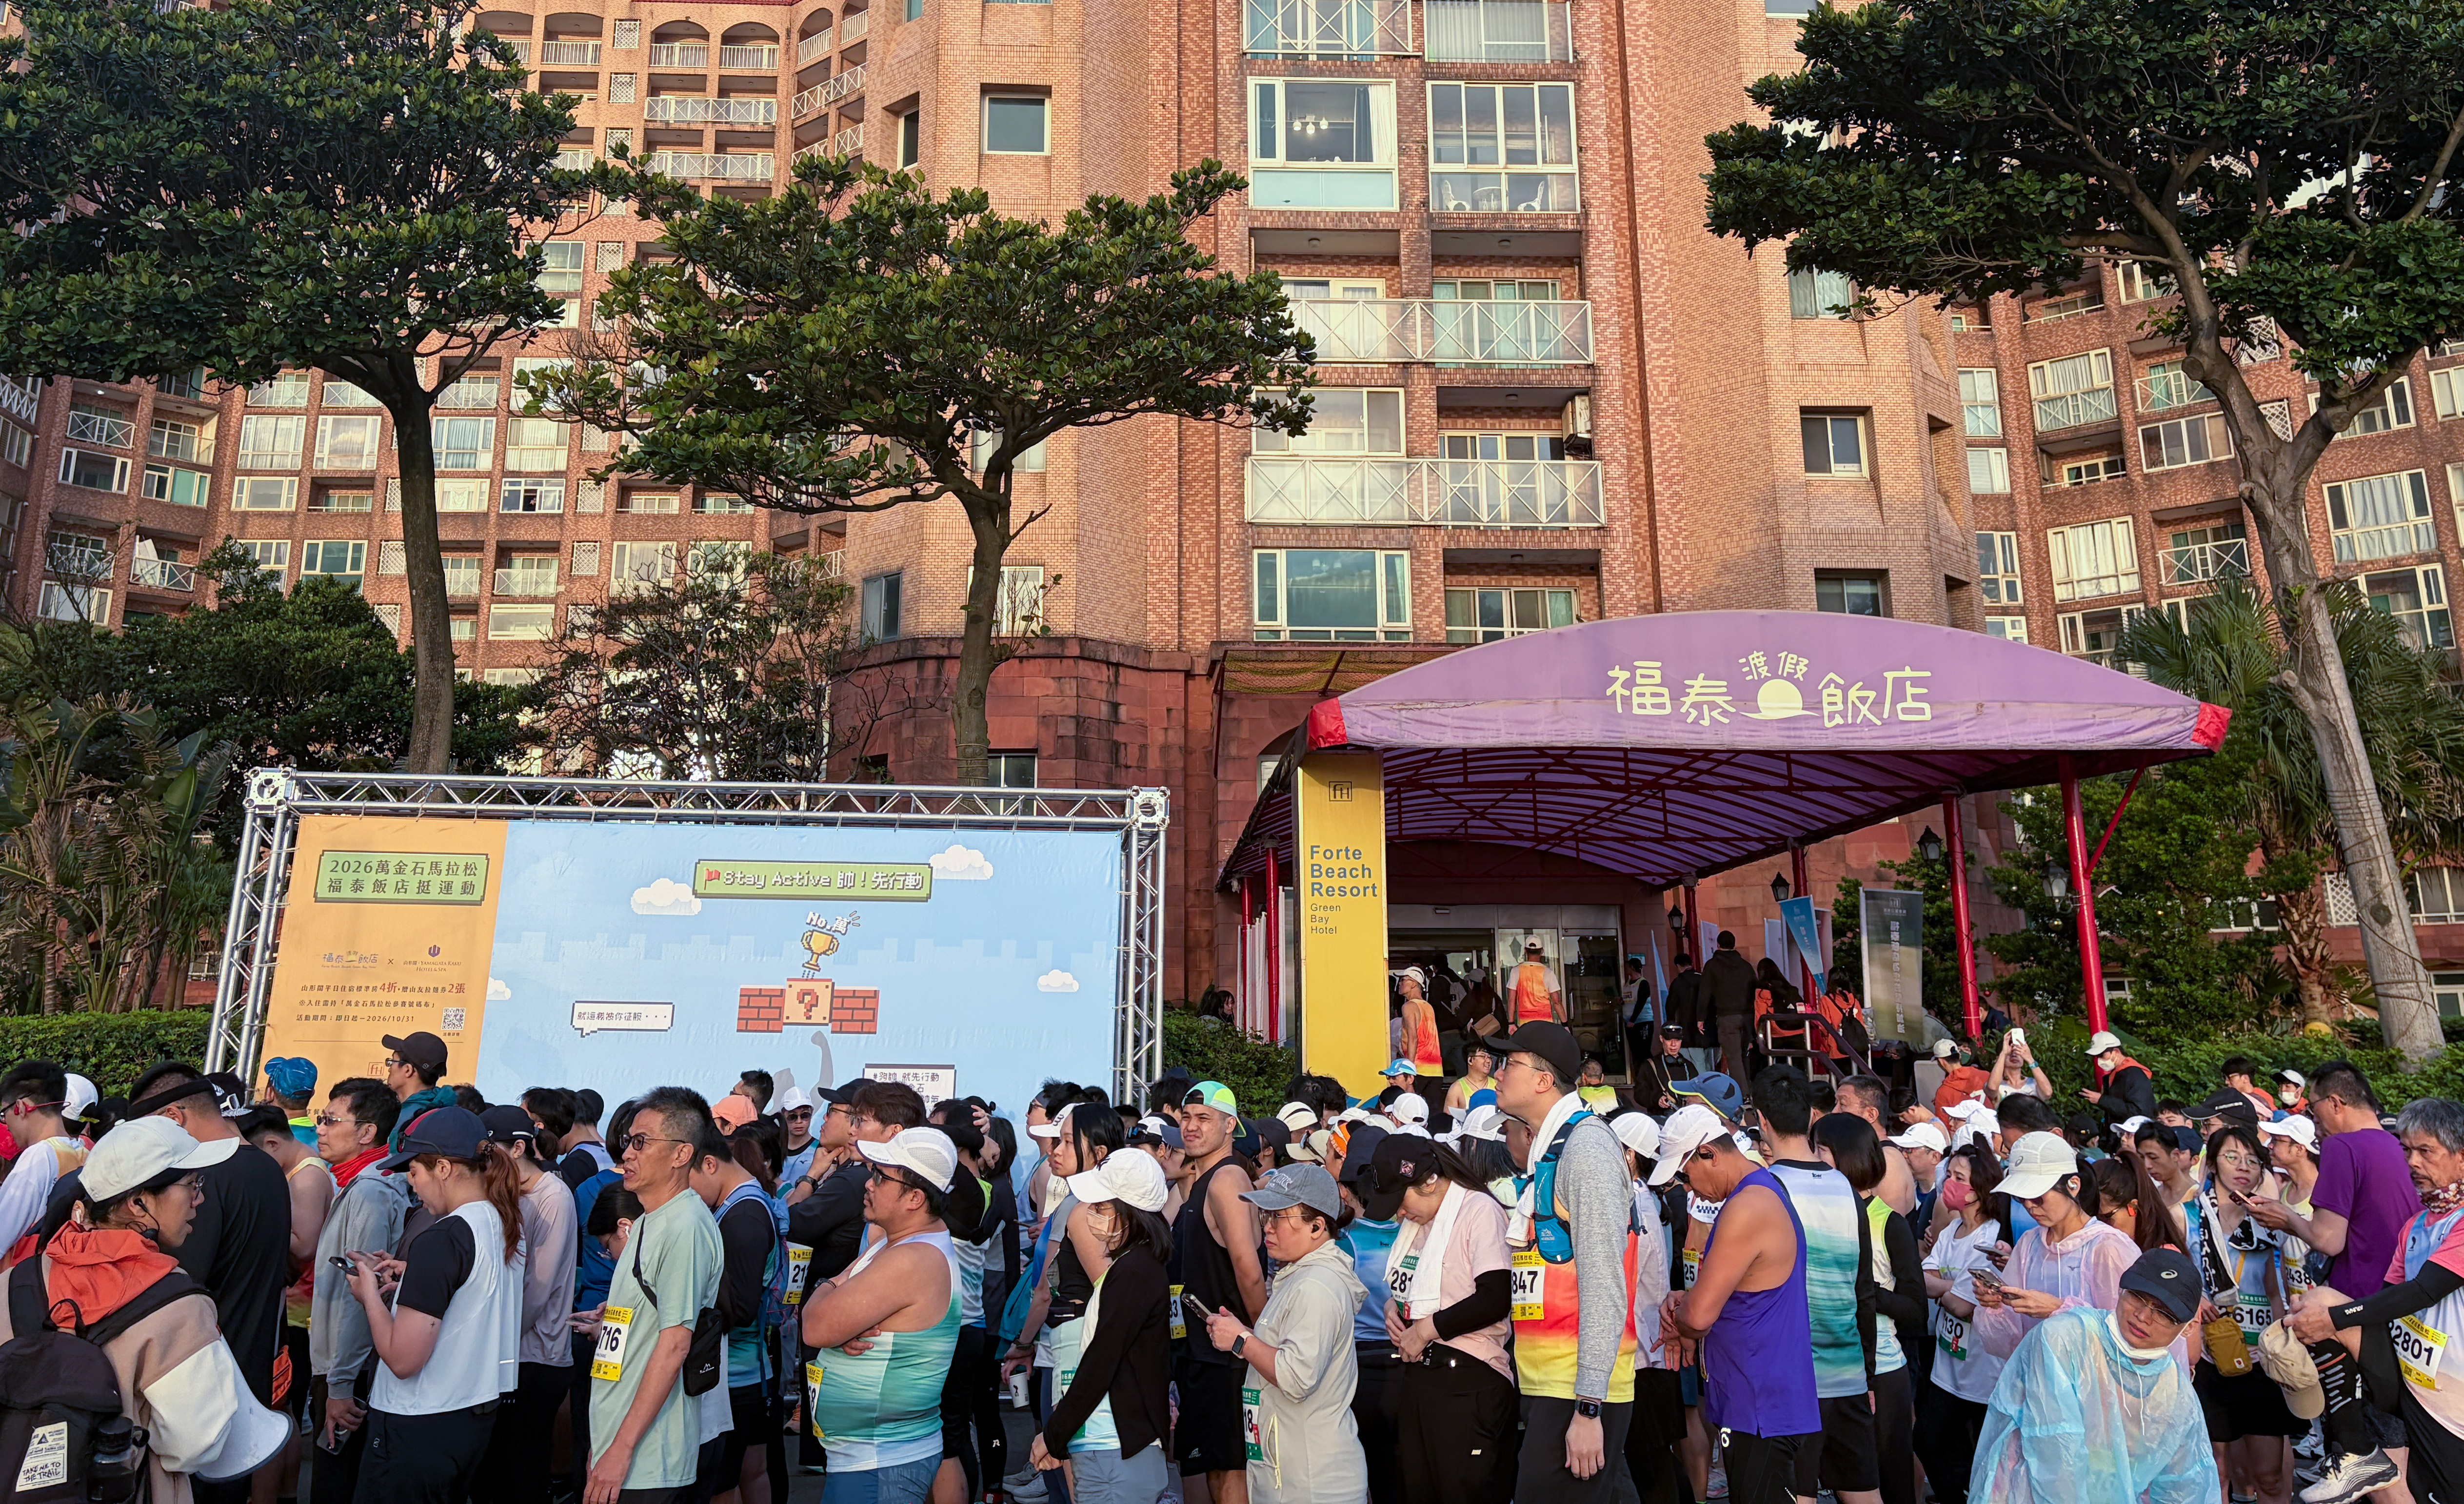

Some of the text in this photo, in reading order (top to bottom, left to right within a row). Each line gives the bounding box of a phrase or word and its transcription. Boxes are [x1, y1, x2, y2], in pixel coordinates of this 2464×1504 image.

[1311, 845, 1362, 860] Forte
[329, 860, 478, 877] 2026萬金石馬拉松
[1311, 864, 1372, 878] Beach
[327, 878, 476, 896] 福泰飯店挺運動
[723, 871, 766, 889] Stay
[772, 871, 832, 887] Active
[1311, 882, 1377, 897] Resort
[1311, 903, 1341, 912] Green
[1311, 915, 1329, 925] Bay
[1311, 926, 1337, 934] Hotel
[792, 1264, 810, 1283] 21
[22, 1464, 39, 1476] TAKE
[23, 1469, 61, 1482] THE TRAIL
